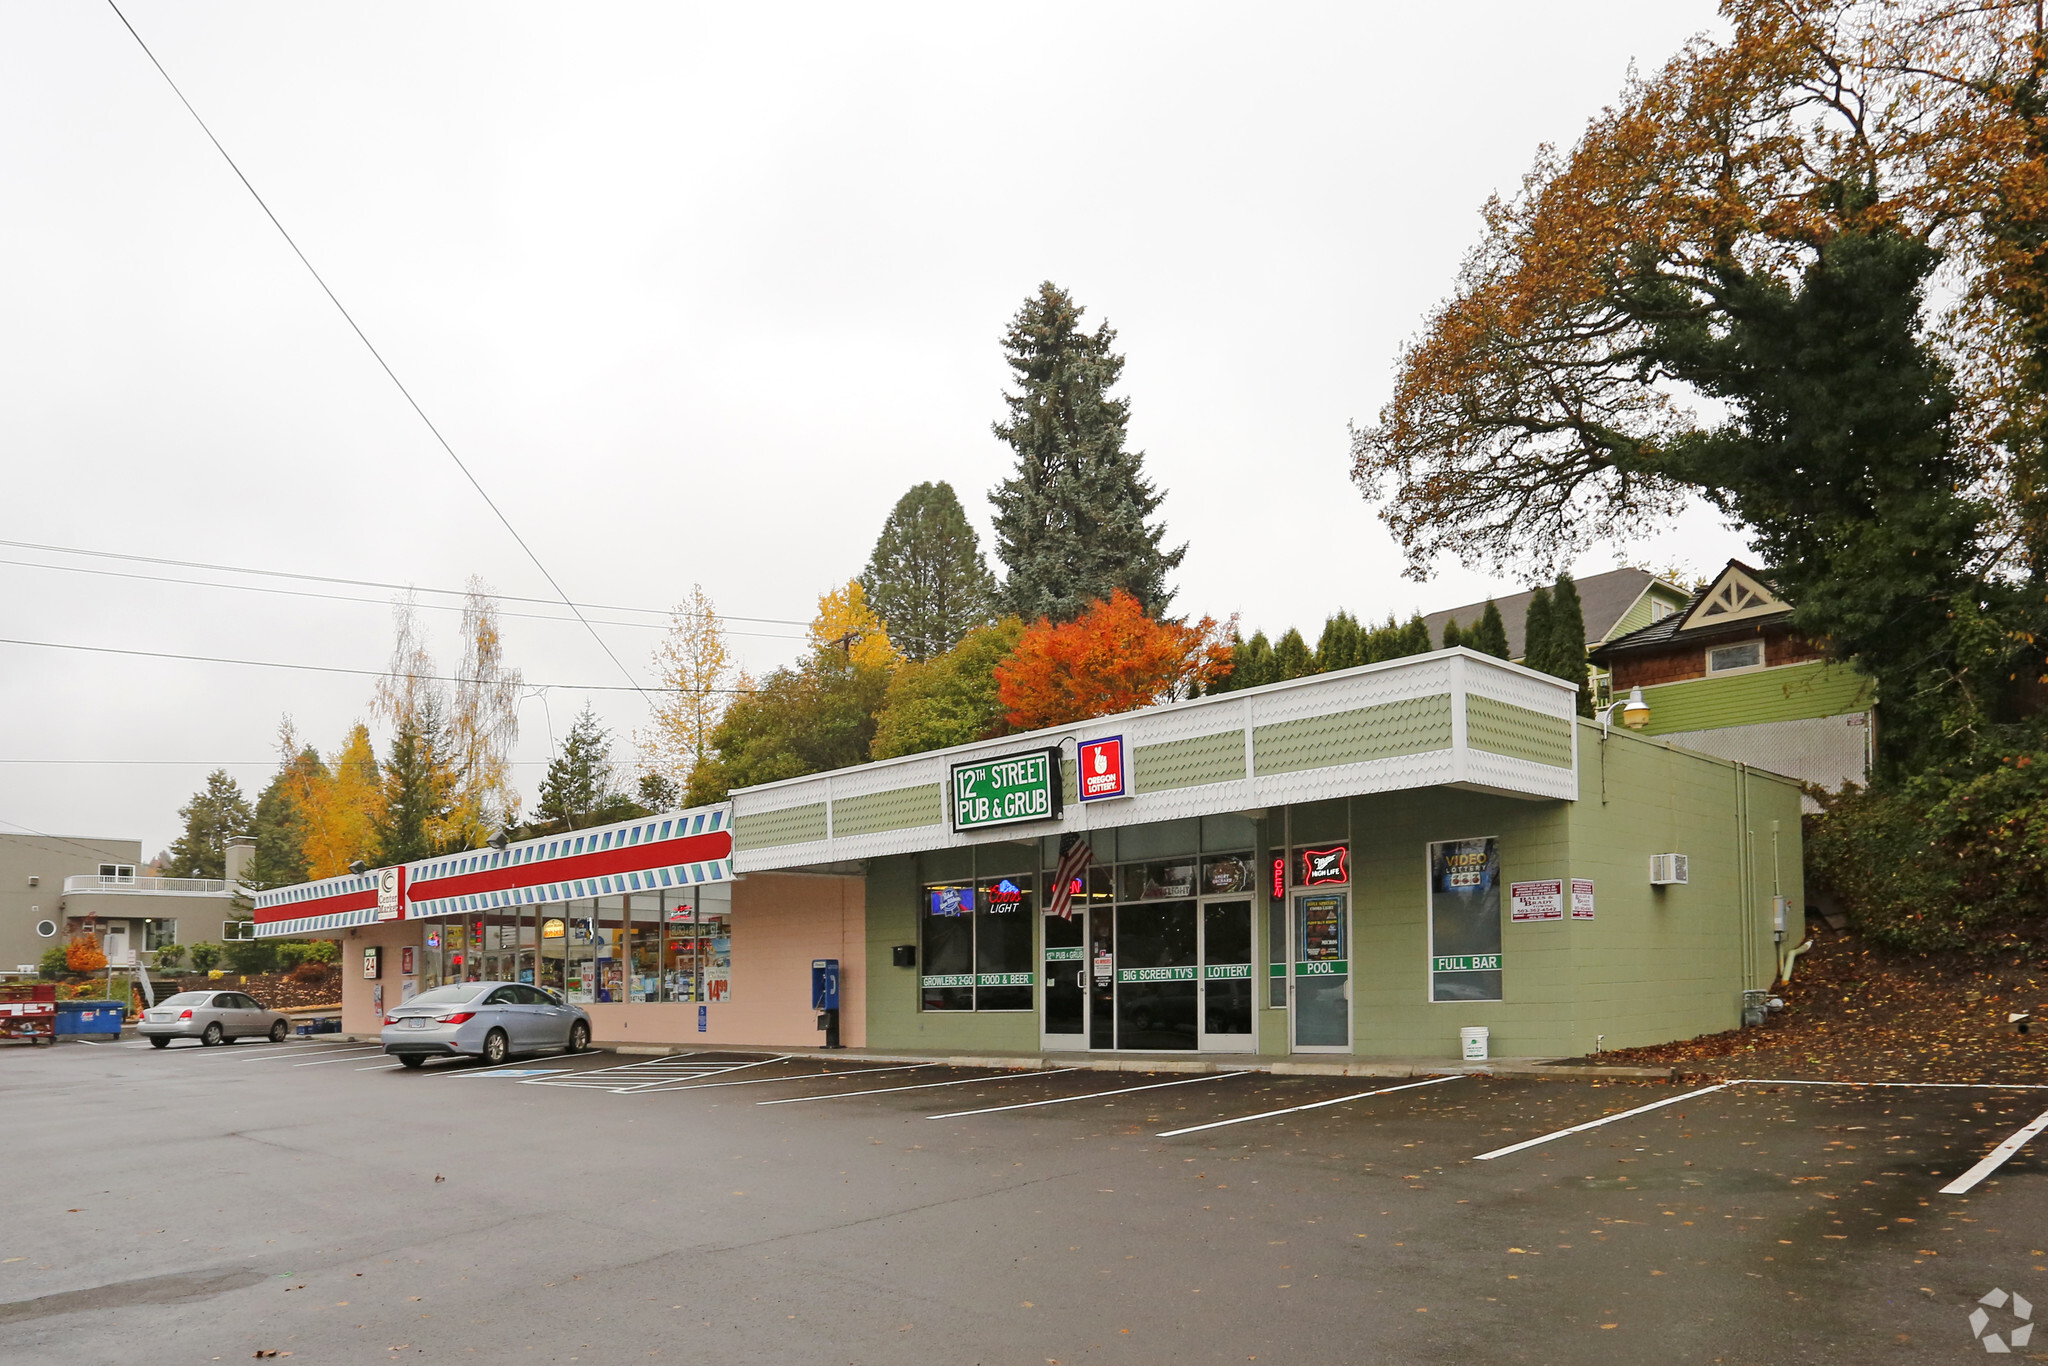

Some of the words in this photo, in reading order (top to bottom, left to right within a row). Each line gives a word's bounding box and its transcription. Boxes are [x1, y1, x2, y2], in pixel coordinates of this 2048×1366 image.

[958, 768, 986, 799] 12TH
[991, 757, 1045, 789] STREET
[1087, 773, 1116, 785] OREGON
[1088, 781, 1116, 793] LOTTERY
[959, 797, 989, 823] PUB
[992, 798, 1002, 819] &
[1004, 788, 1047, 817] GRUB
[1446, 852, 1487, 867] VIDEO
[1311, 869, 1326, 878] HIGH
[1326, 867, 1340, 876] LIFE
[1446, 865, 1487, 874] LOTTERY
[1273, 859, 1285, 898] OPEN
[990, 903, 1020, 914] LIGHT
[1055, 951, 1066, 959] PUB
[1070, 950, 1084, 959] GRUB
[366, 958, 375, 971] 24
[1307, 962, 1335, 974] POOL
[1438, 958, 1467, 970] FULL
[1472, 956, 1498, 969] BAR
[1123, 970, 1137, 980] BIG
[1139, 969, 1172, 980] SCREEN
[1175, 968, 1193, 979] TV'S
[1208, 966, 1249, 978] LOTTERY
[923, 976, 957, 986] GROWLERS
[958, 976, 974, 985] 2-GO
[981, 975, 1000, 985] FOOD
[1002, 975, 1008, 983] &
[1010, 974, 1029, 984] BEER
